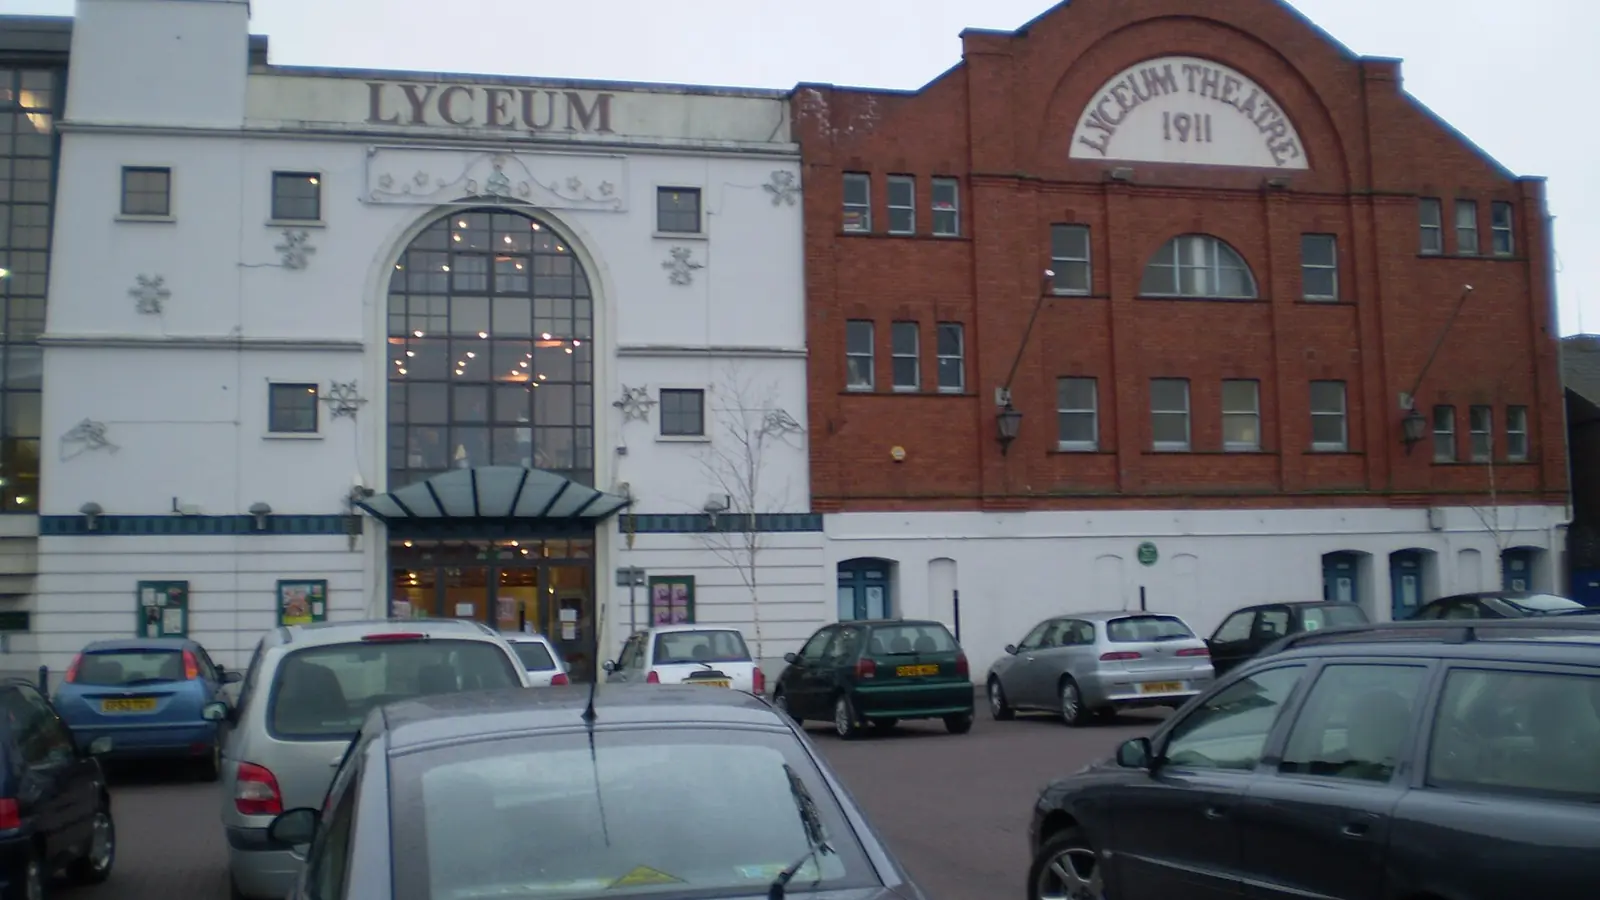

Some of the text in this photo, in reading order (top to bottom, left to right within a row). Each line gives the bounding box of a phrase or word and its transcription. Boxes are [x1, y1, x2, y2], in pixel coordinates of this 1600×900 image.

[364, 82, 615, 134] LYCEUM
[1079, 63, 1300, 167] LYCEUM THEATRE
[1162, 110, 1213, 143] 1911
